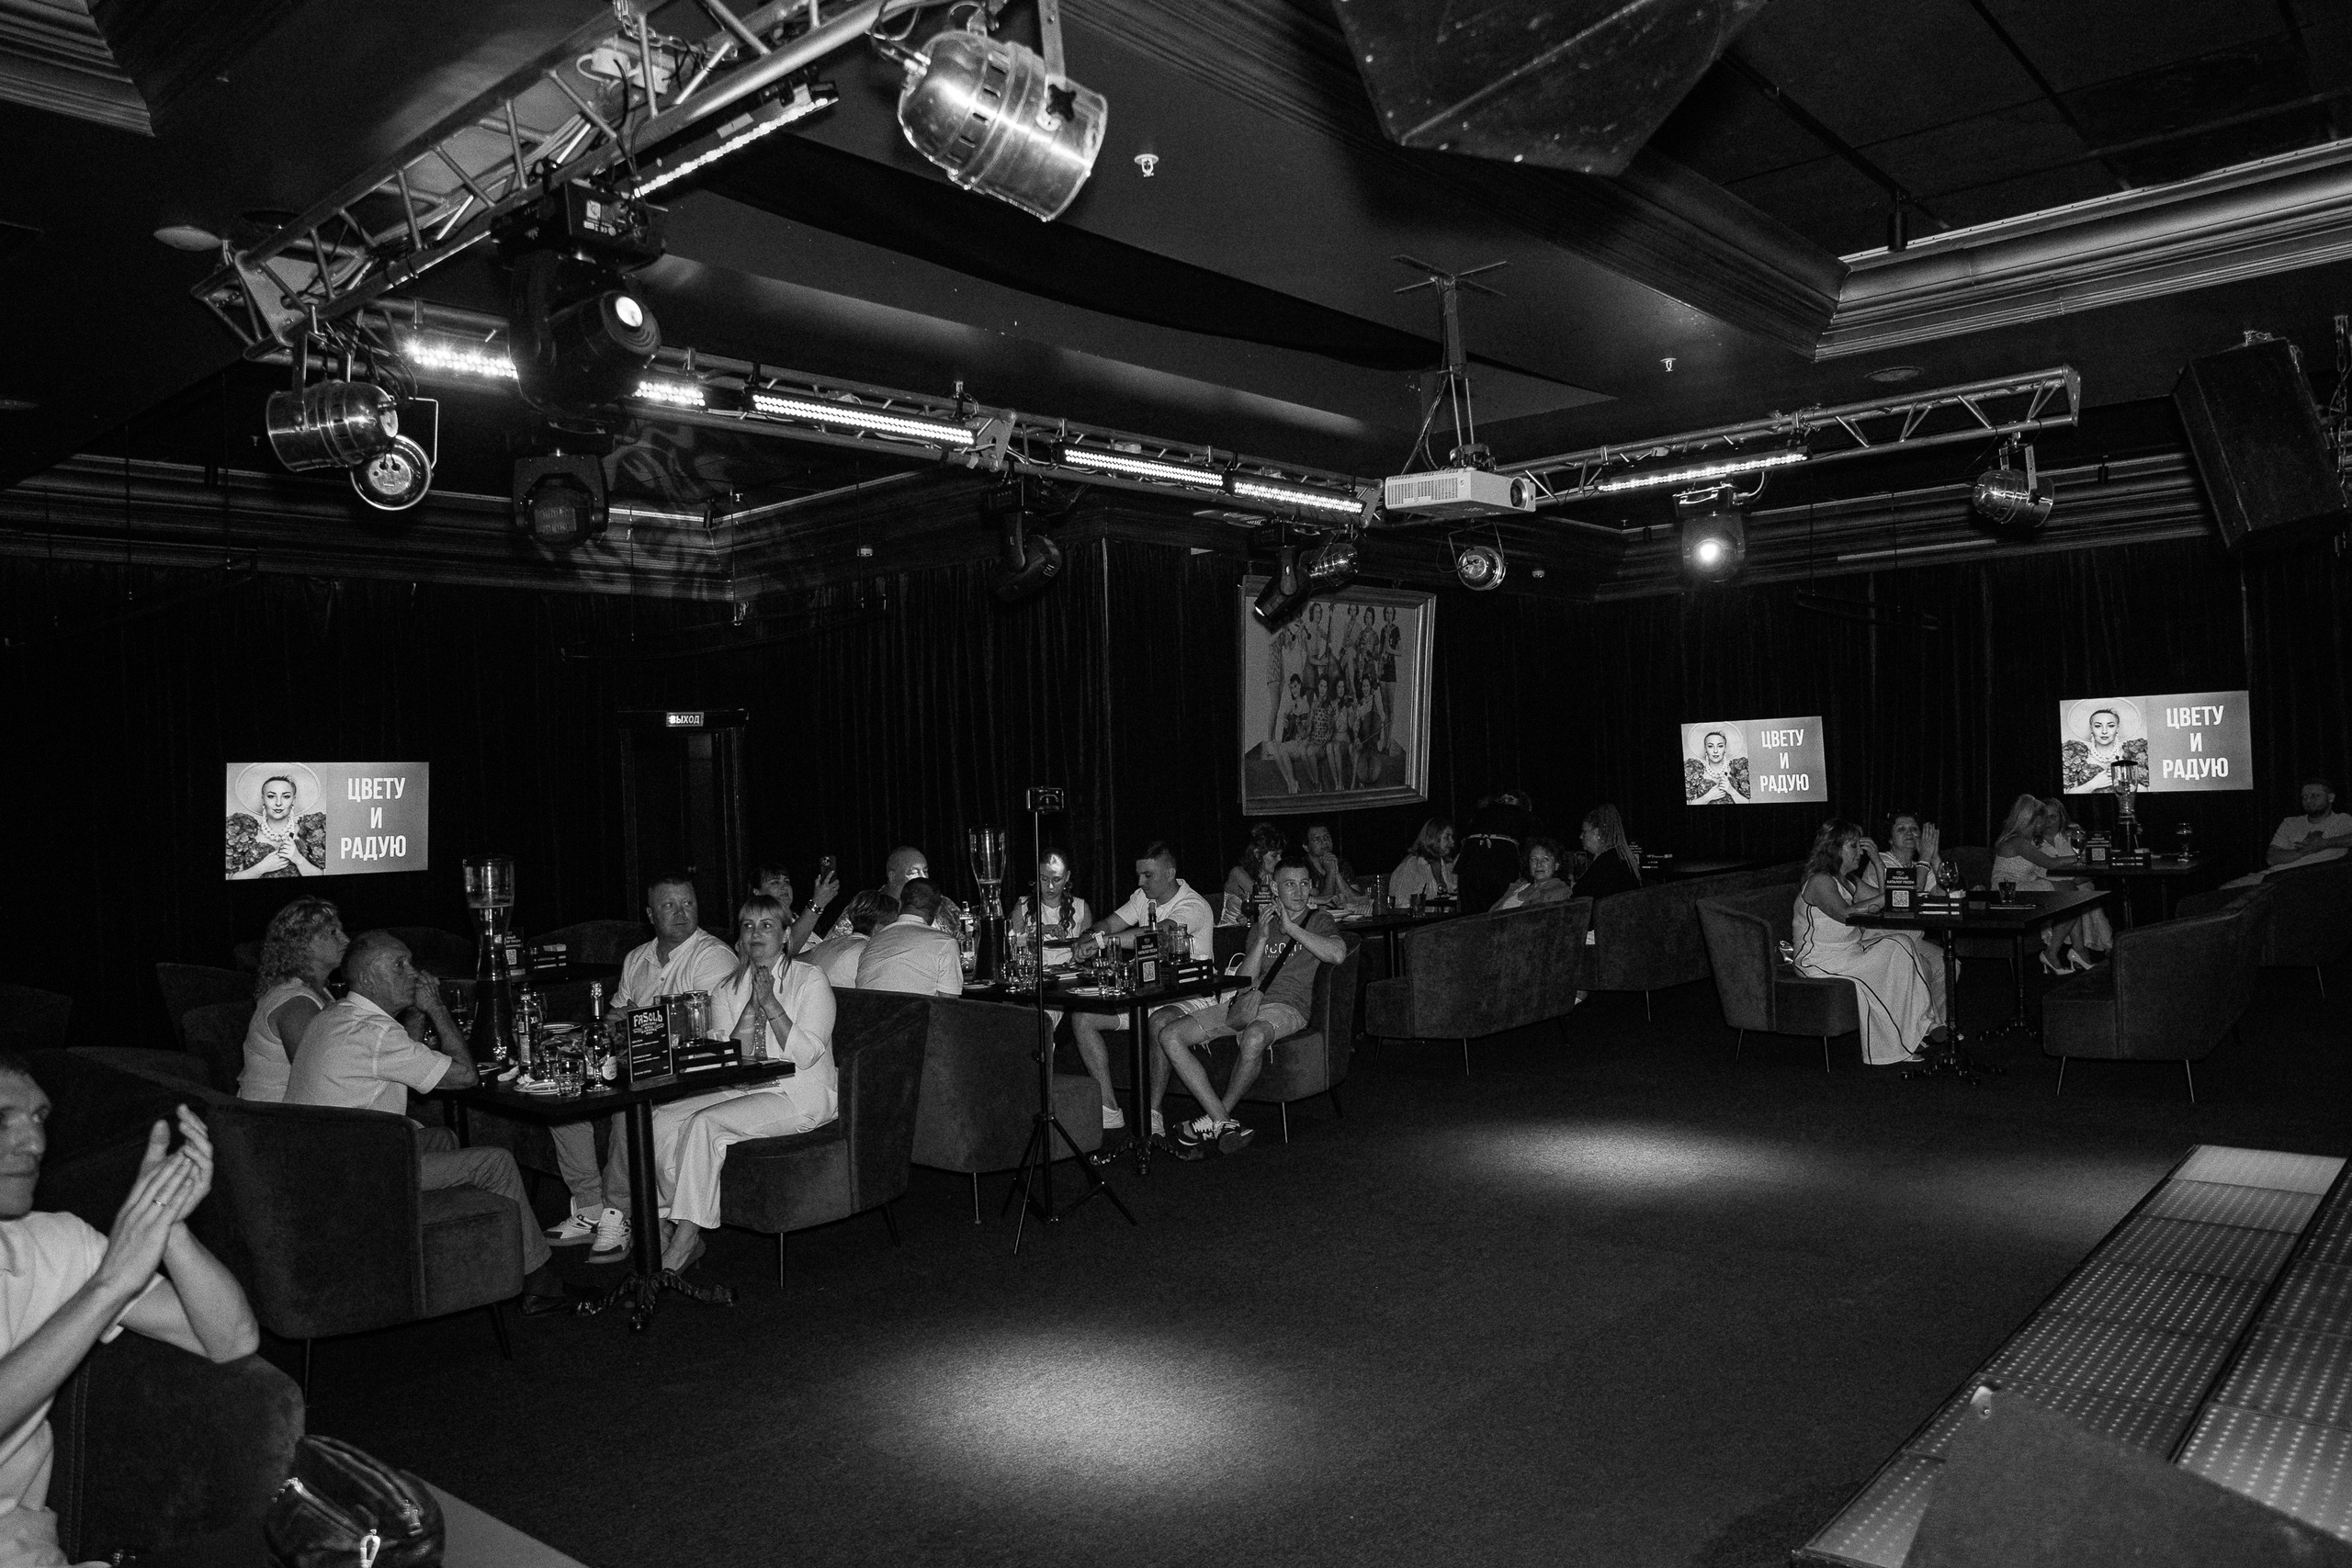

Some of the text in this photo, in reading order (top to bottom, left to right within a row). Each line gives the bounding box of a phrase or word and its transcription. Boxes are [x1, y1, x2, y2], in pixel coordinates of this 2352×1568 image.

[669, 715, 700, 724] ВЫХОД
[2166, 705, 2223, 729] ЦВЕТУ
[1761, 729, 1804, 750] ЦВЕТУ
[2189, 732, 2202, 752] И
[1780, 751, 1790, 770] И
[2162, 757, 2229, 781] РАДУЮ
[347, 777, 406, 802] ЦВЕТУ
[1759, 773, 1810, 794] РАДУЮ
[370, 807, 382, 829] И
[340, 834, 407, 861] РАДУЮ
